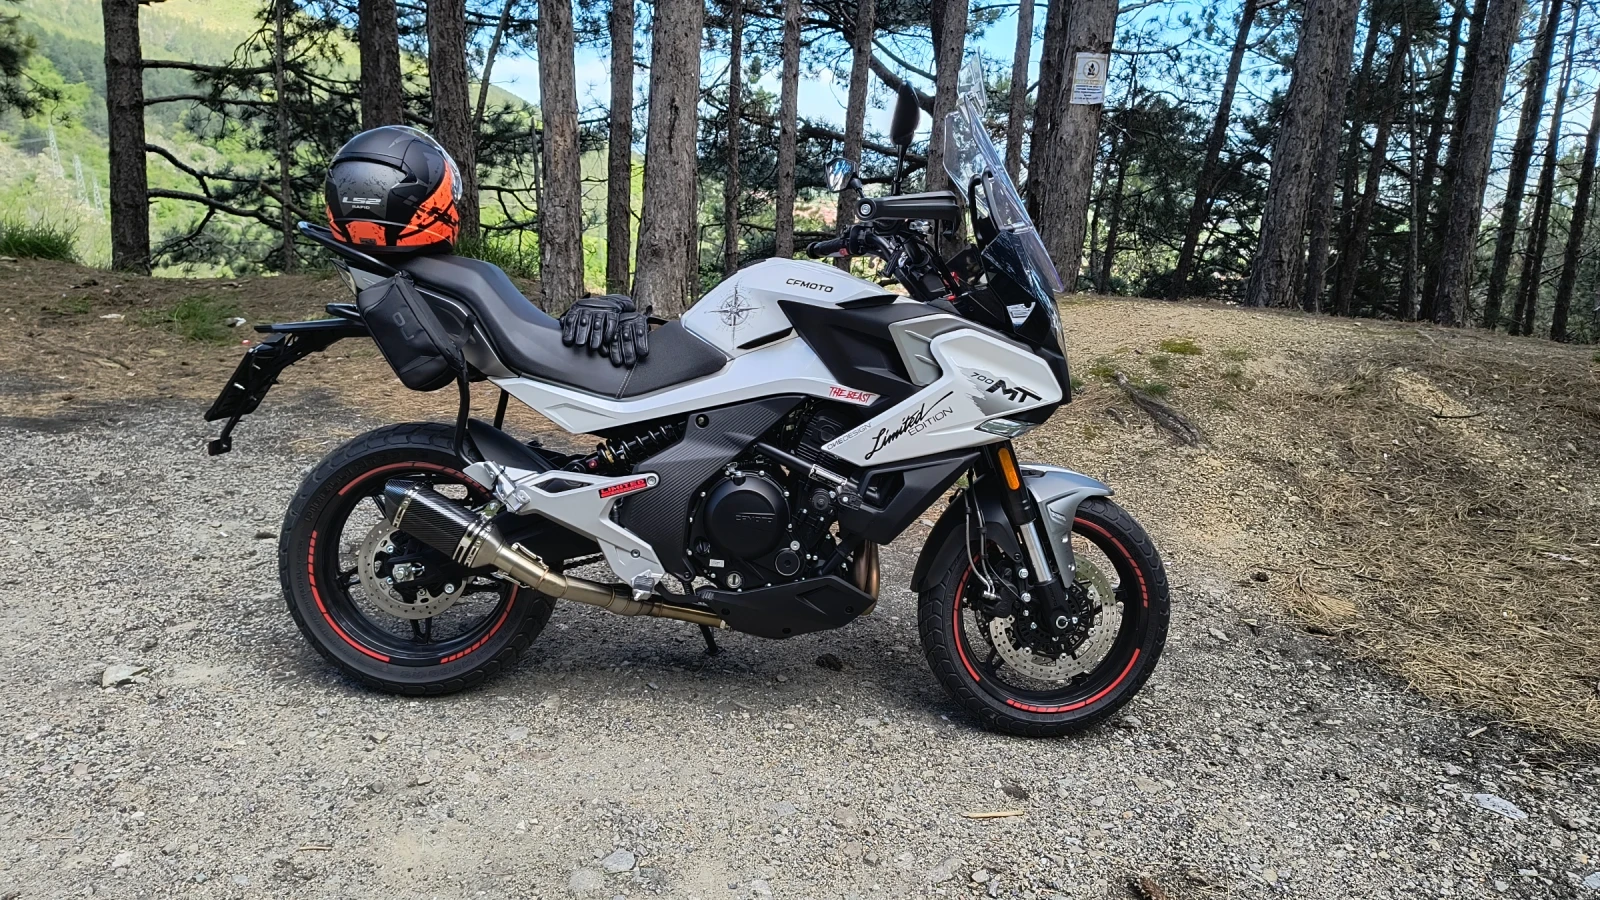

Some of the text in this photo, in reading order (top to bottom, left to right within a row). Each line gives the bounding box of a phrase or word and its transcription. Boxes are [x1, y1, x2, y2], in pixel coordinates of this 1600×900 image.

[342, 196, 382, 205] LS2
[785, 278, 834, 293] CFMOTO
[829, 386, 876, 403] THE BEAST
[970, 371, 1043, 403] 700 MT
[864, 391, 954, 460] Limited
[908, 406, 954, 436] EDITION
[600, 479, 645, 494] LIMITED
